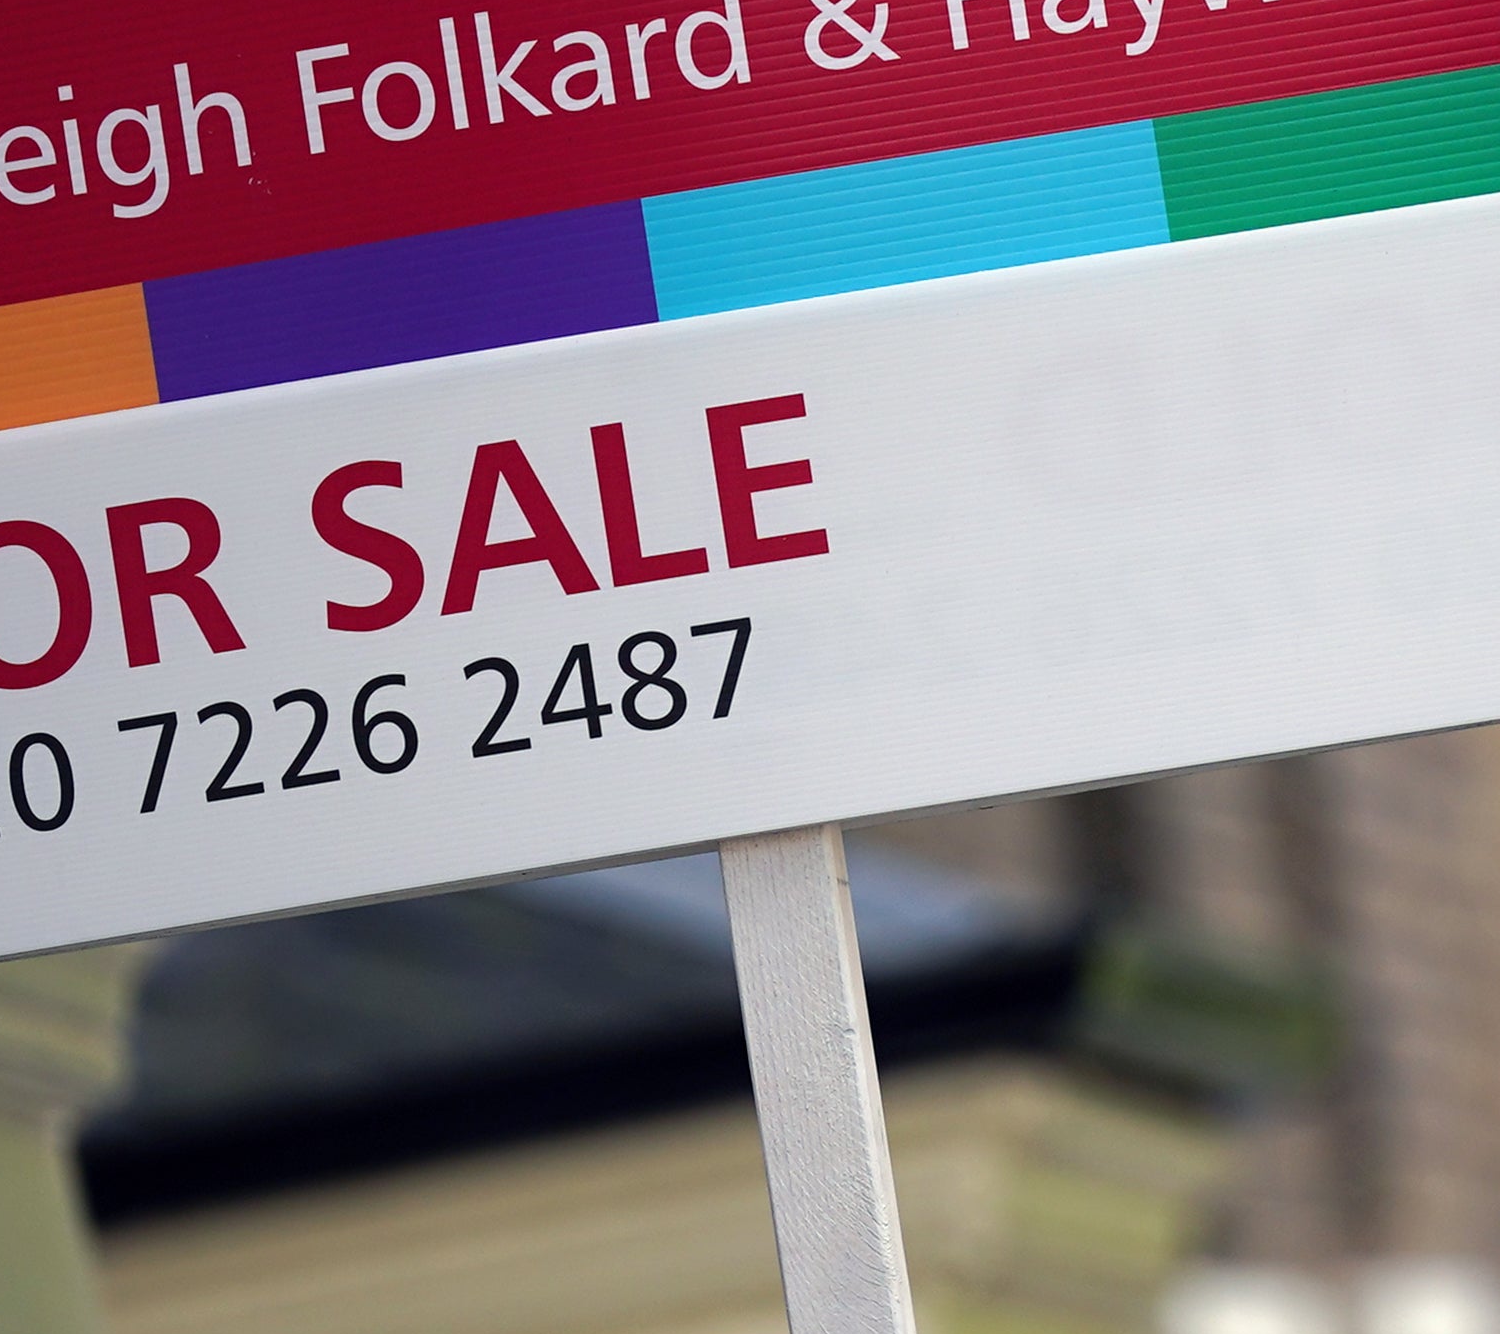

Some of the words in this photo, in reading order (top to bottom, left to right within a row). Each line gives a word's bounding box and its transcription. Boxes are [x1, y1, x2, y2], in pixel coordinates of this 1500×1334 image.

[310, 392, 831, 634] SALE
[116, 672, 420, 816] 7226
[461, 615, 755, 760] 2487
